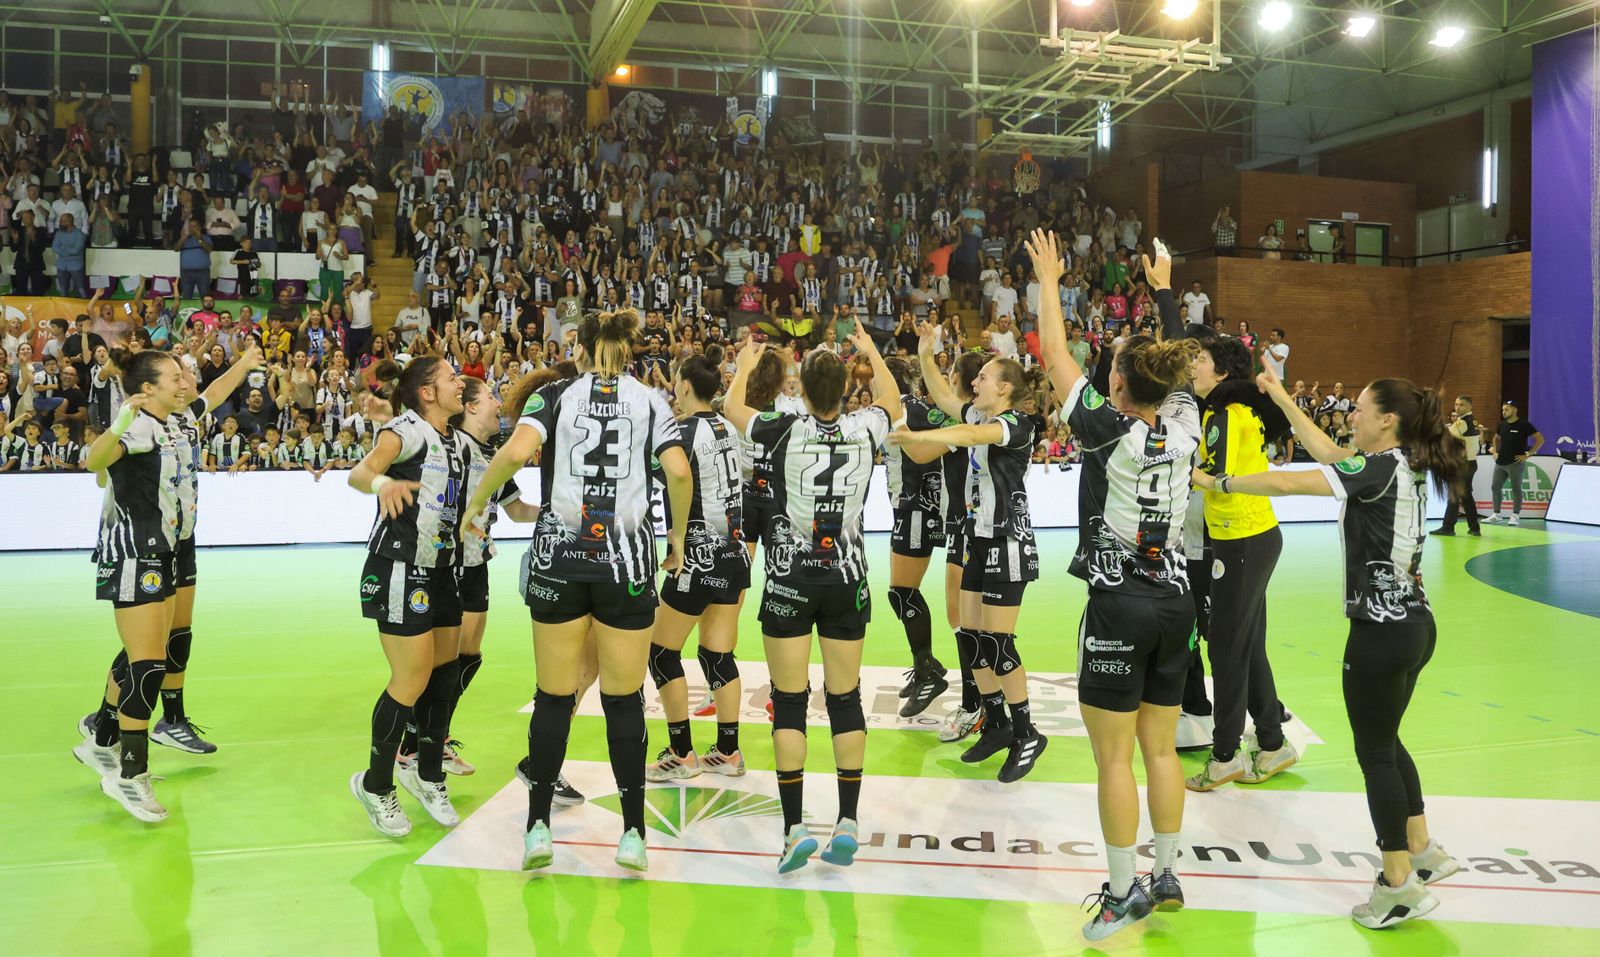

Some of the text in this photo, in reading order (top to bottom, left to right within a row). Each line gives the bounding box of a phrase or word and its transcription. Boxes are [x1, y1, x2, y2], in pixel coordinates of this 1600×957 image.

[570, 414, 632, 479] 23
[713, 448, 738, 500] 19
[801, 443, 861, 496] 22
[584, 482, 615, 497] raíz
[1136, 461, 1173, 509] 9
[815, 500, 844, 513] raíz
[362, 583, 381, 595] CSIF
[700, 578, 729, 590] TORRES
[528, 584, 560, 602] TORRES
[765, 602, 799, 618] TORRES
[1088, 662, 1132, 675] TORRES
